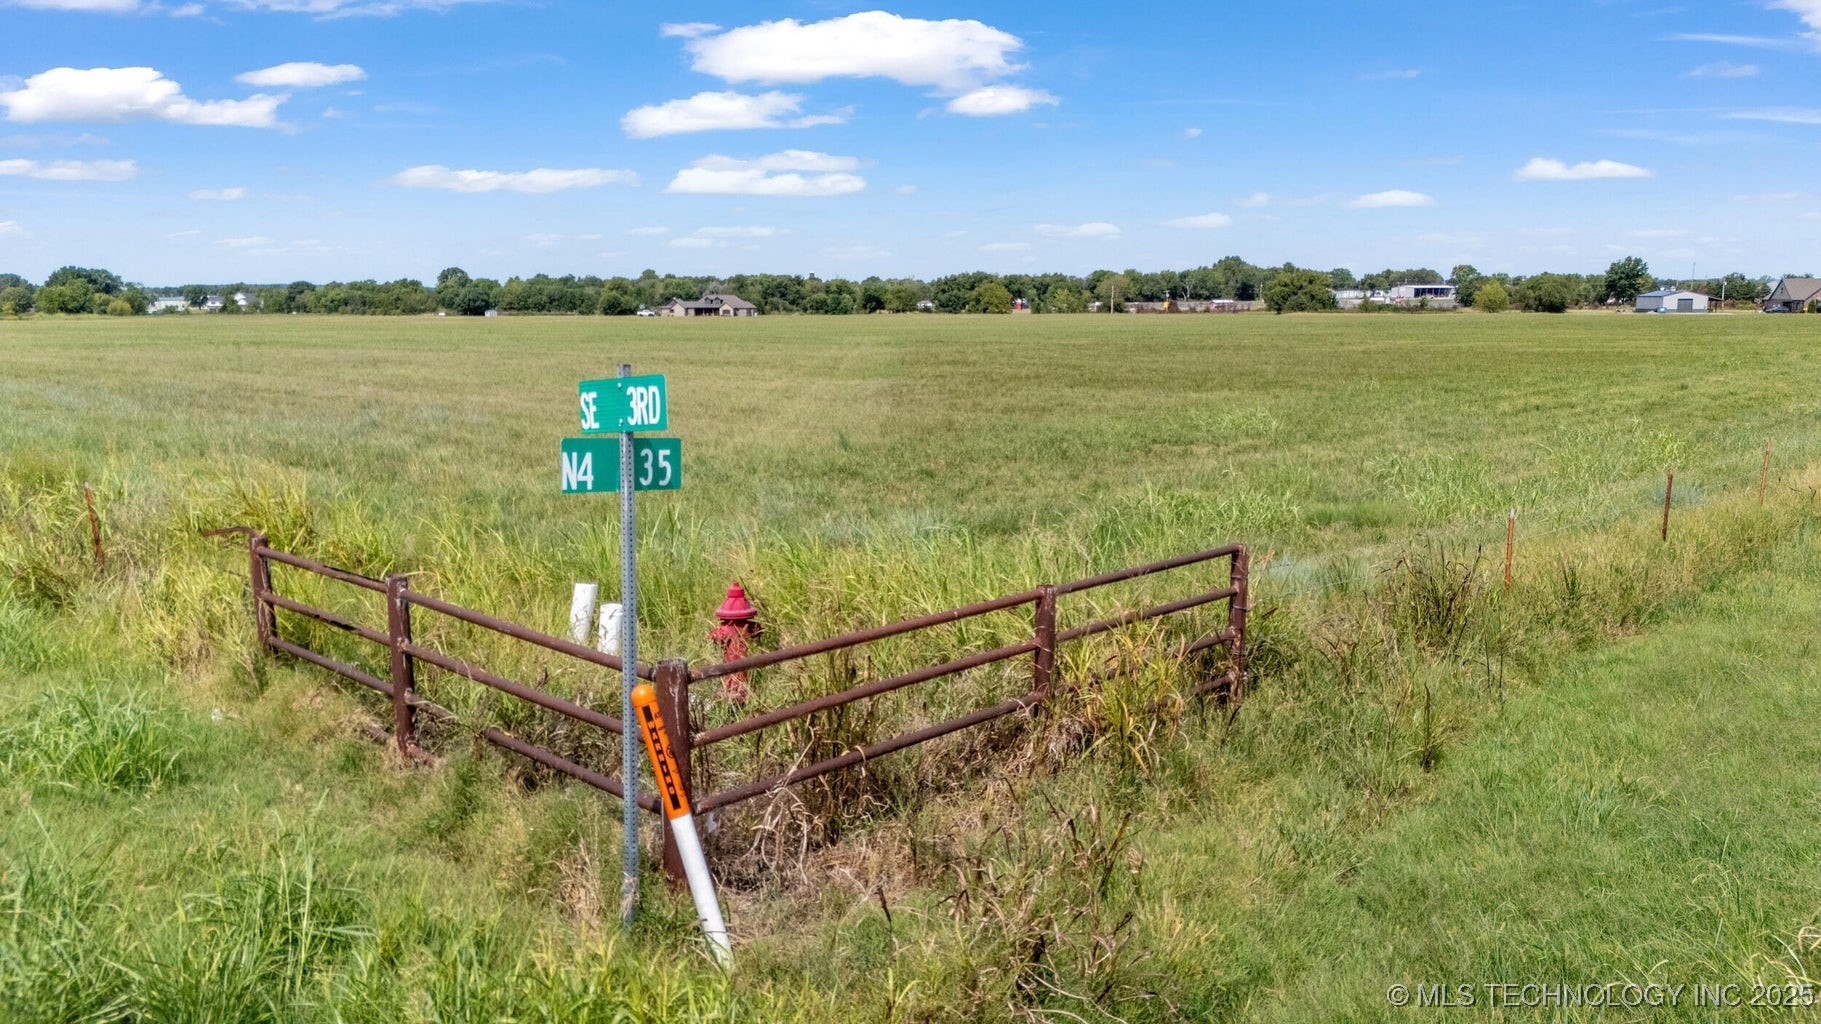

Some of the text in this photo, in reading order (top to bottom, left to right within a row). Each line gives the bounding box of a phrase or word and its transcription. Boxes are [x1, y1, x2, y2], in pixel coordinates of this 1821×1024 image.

[580, 385, 661, 430] SE 3RD
[561, 448, 672, 490] N4 35
[647, 721, 675, 795] WARNING
